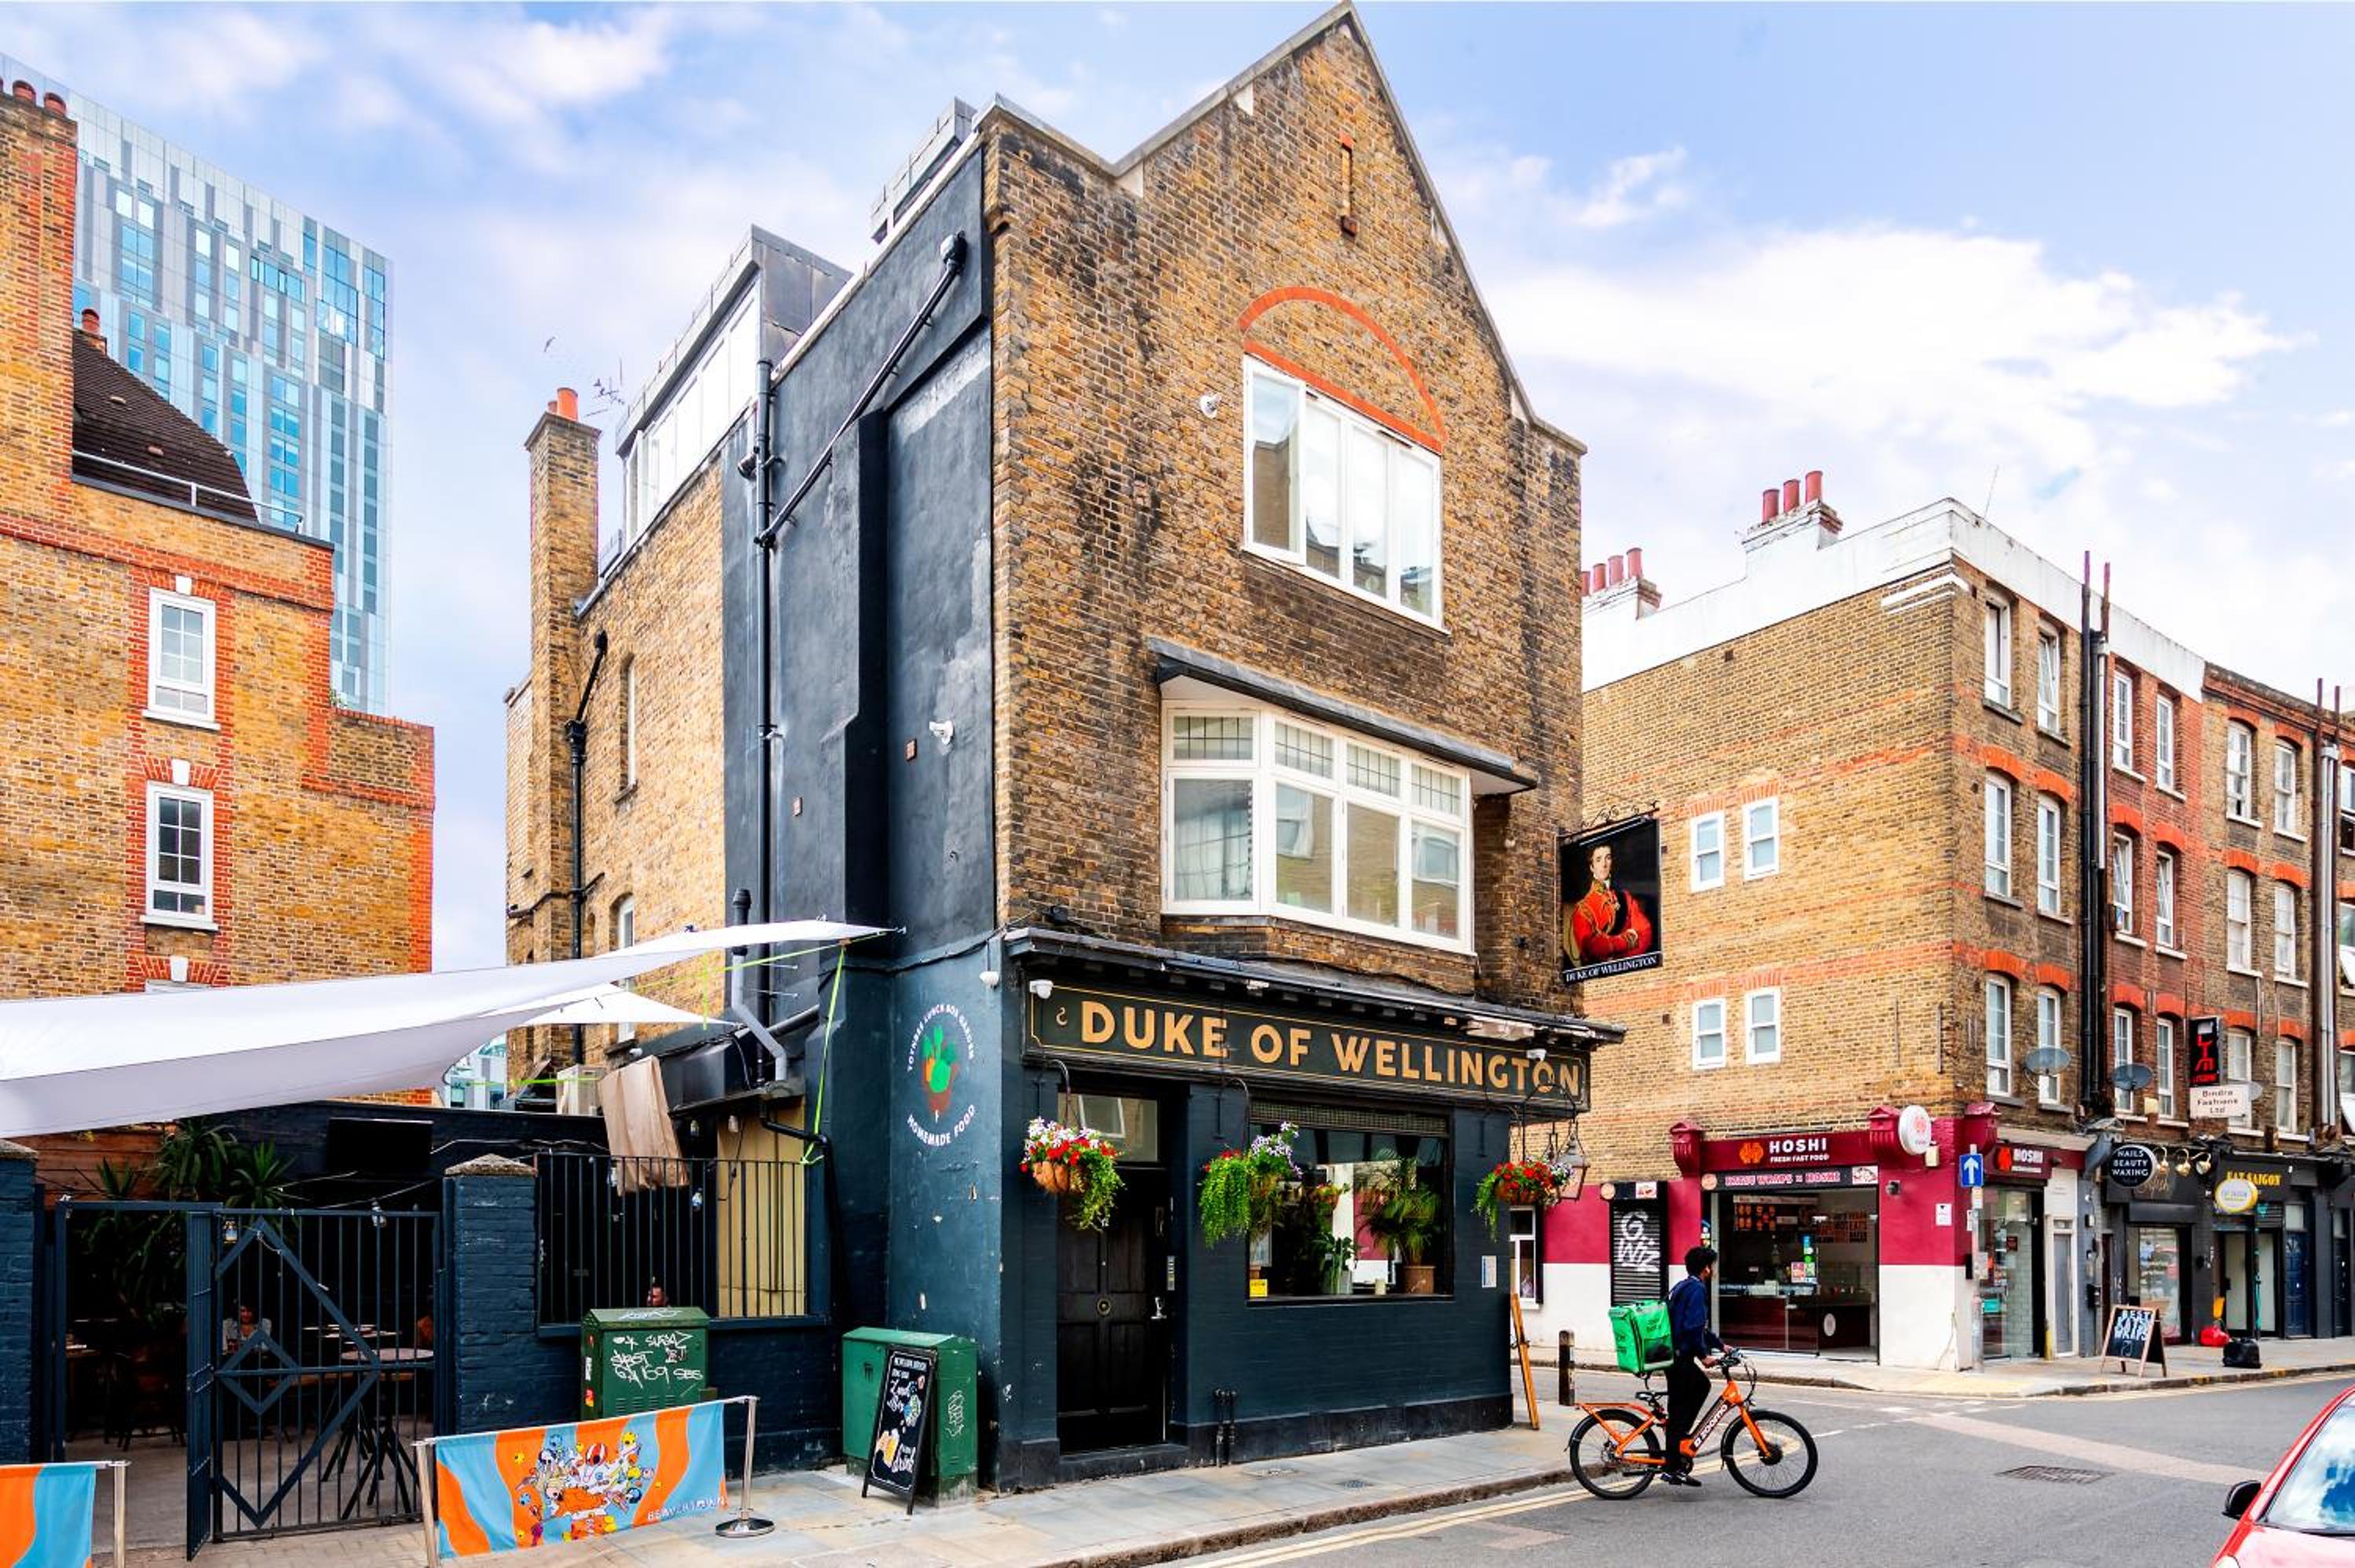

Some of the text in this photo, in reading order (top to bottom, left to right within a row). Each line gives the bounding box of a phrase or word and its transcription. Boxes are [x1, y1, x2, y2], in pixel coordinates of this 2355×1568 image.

[1566, 956, 1658, 982] DUKE OF WELLINGTON
[1081, 1001, 1579, 1097] DUKE OF WELLINGTON
[907, 1104, 975, 1147] HOMEMADE FOOD
[1769, 1137, 1827, 1154] HOSHI
[2122, 1310, 2152, 1319] BEST
